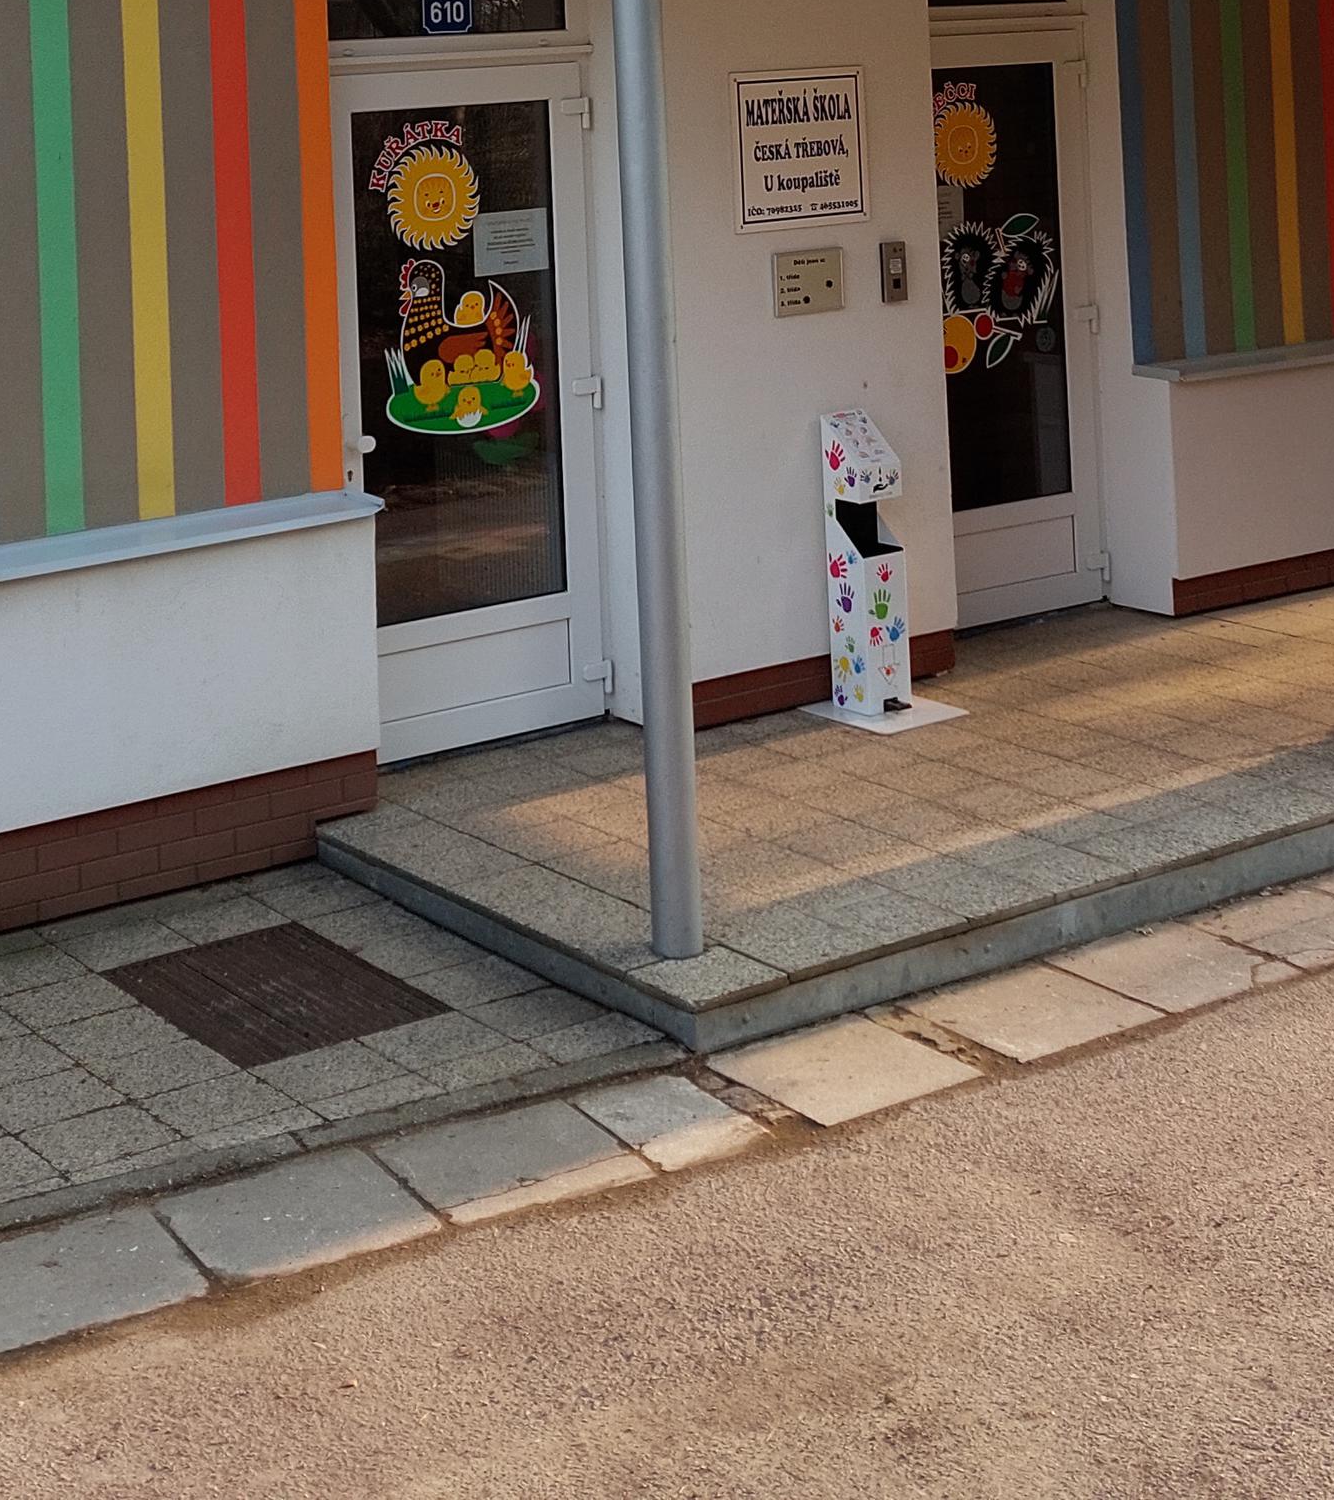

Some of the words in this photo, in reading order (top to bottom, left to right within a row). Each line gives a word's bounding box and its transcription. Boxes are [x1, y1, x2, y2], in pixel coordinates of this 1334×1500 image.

[430, 1, 465, 23] 610
[745, 88, 811, 127] MATEŘSKÁ
[812, 87, 852, 122] ŠKOLA
[932, 81, 976, 116] EČCI
[368, 120, 463, 193] KUŘÁTKA
[753, 138, 793, 162] ČESKÁ
[794, 134, 849, 159] TŘEBOVÁ,
[763, 175, 774, 192] U
[777, 169, 841, 193] koupaliště
